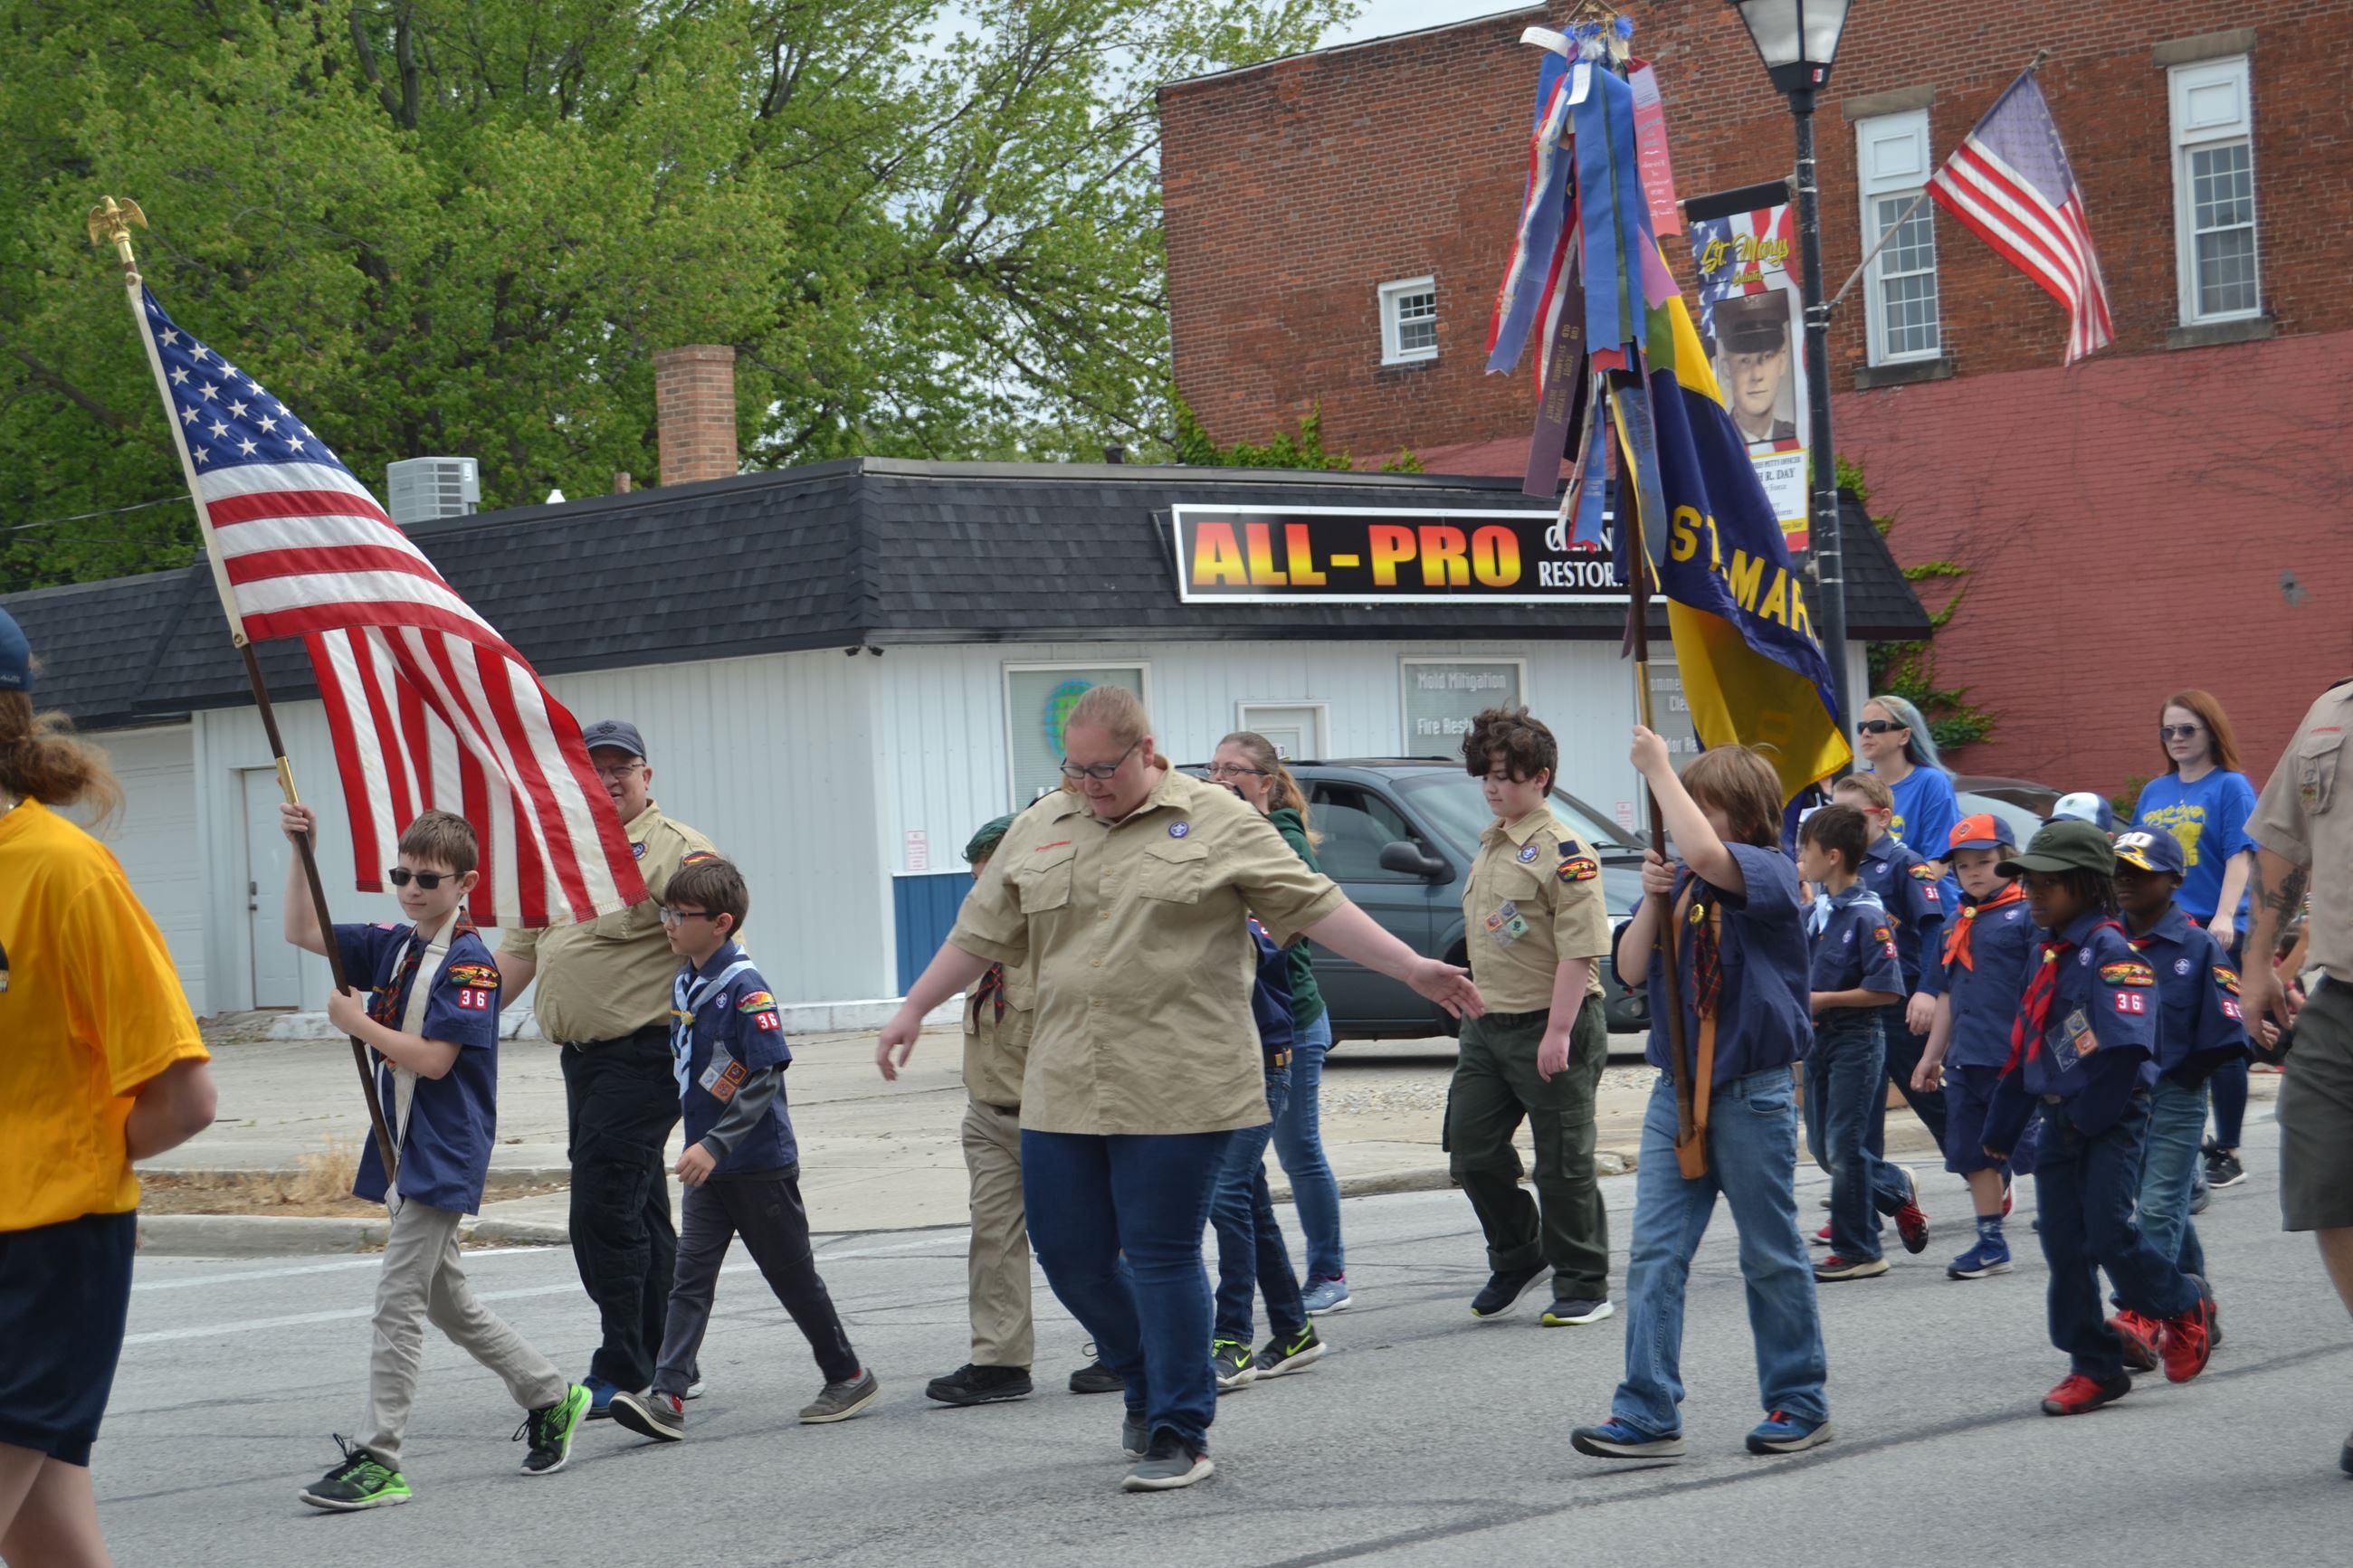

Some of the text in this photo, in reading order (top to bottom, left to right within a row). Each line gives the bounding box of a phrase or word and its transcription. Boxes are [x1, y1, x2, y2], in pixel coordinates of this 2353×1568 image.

[1700, 233, 1789, 273] St. Marys
[1777, 468, 1796, 480] DAY
[1192, 521, 1521, 587] ALL-PRO
[1538, 561, 1624, 587] RESTOR
[1729, 548, 1820, 651] MAR
[1416, 672, 1507, 691] Mold Mitigation
[1416, 717, 1475, 735] Fire Resto
[462, 990, 486, 1007] 36
[2117, 993, 2141, 1011] 36
[757, 1012, 777, 1030] 36
